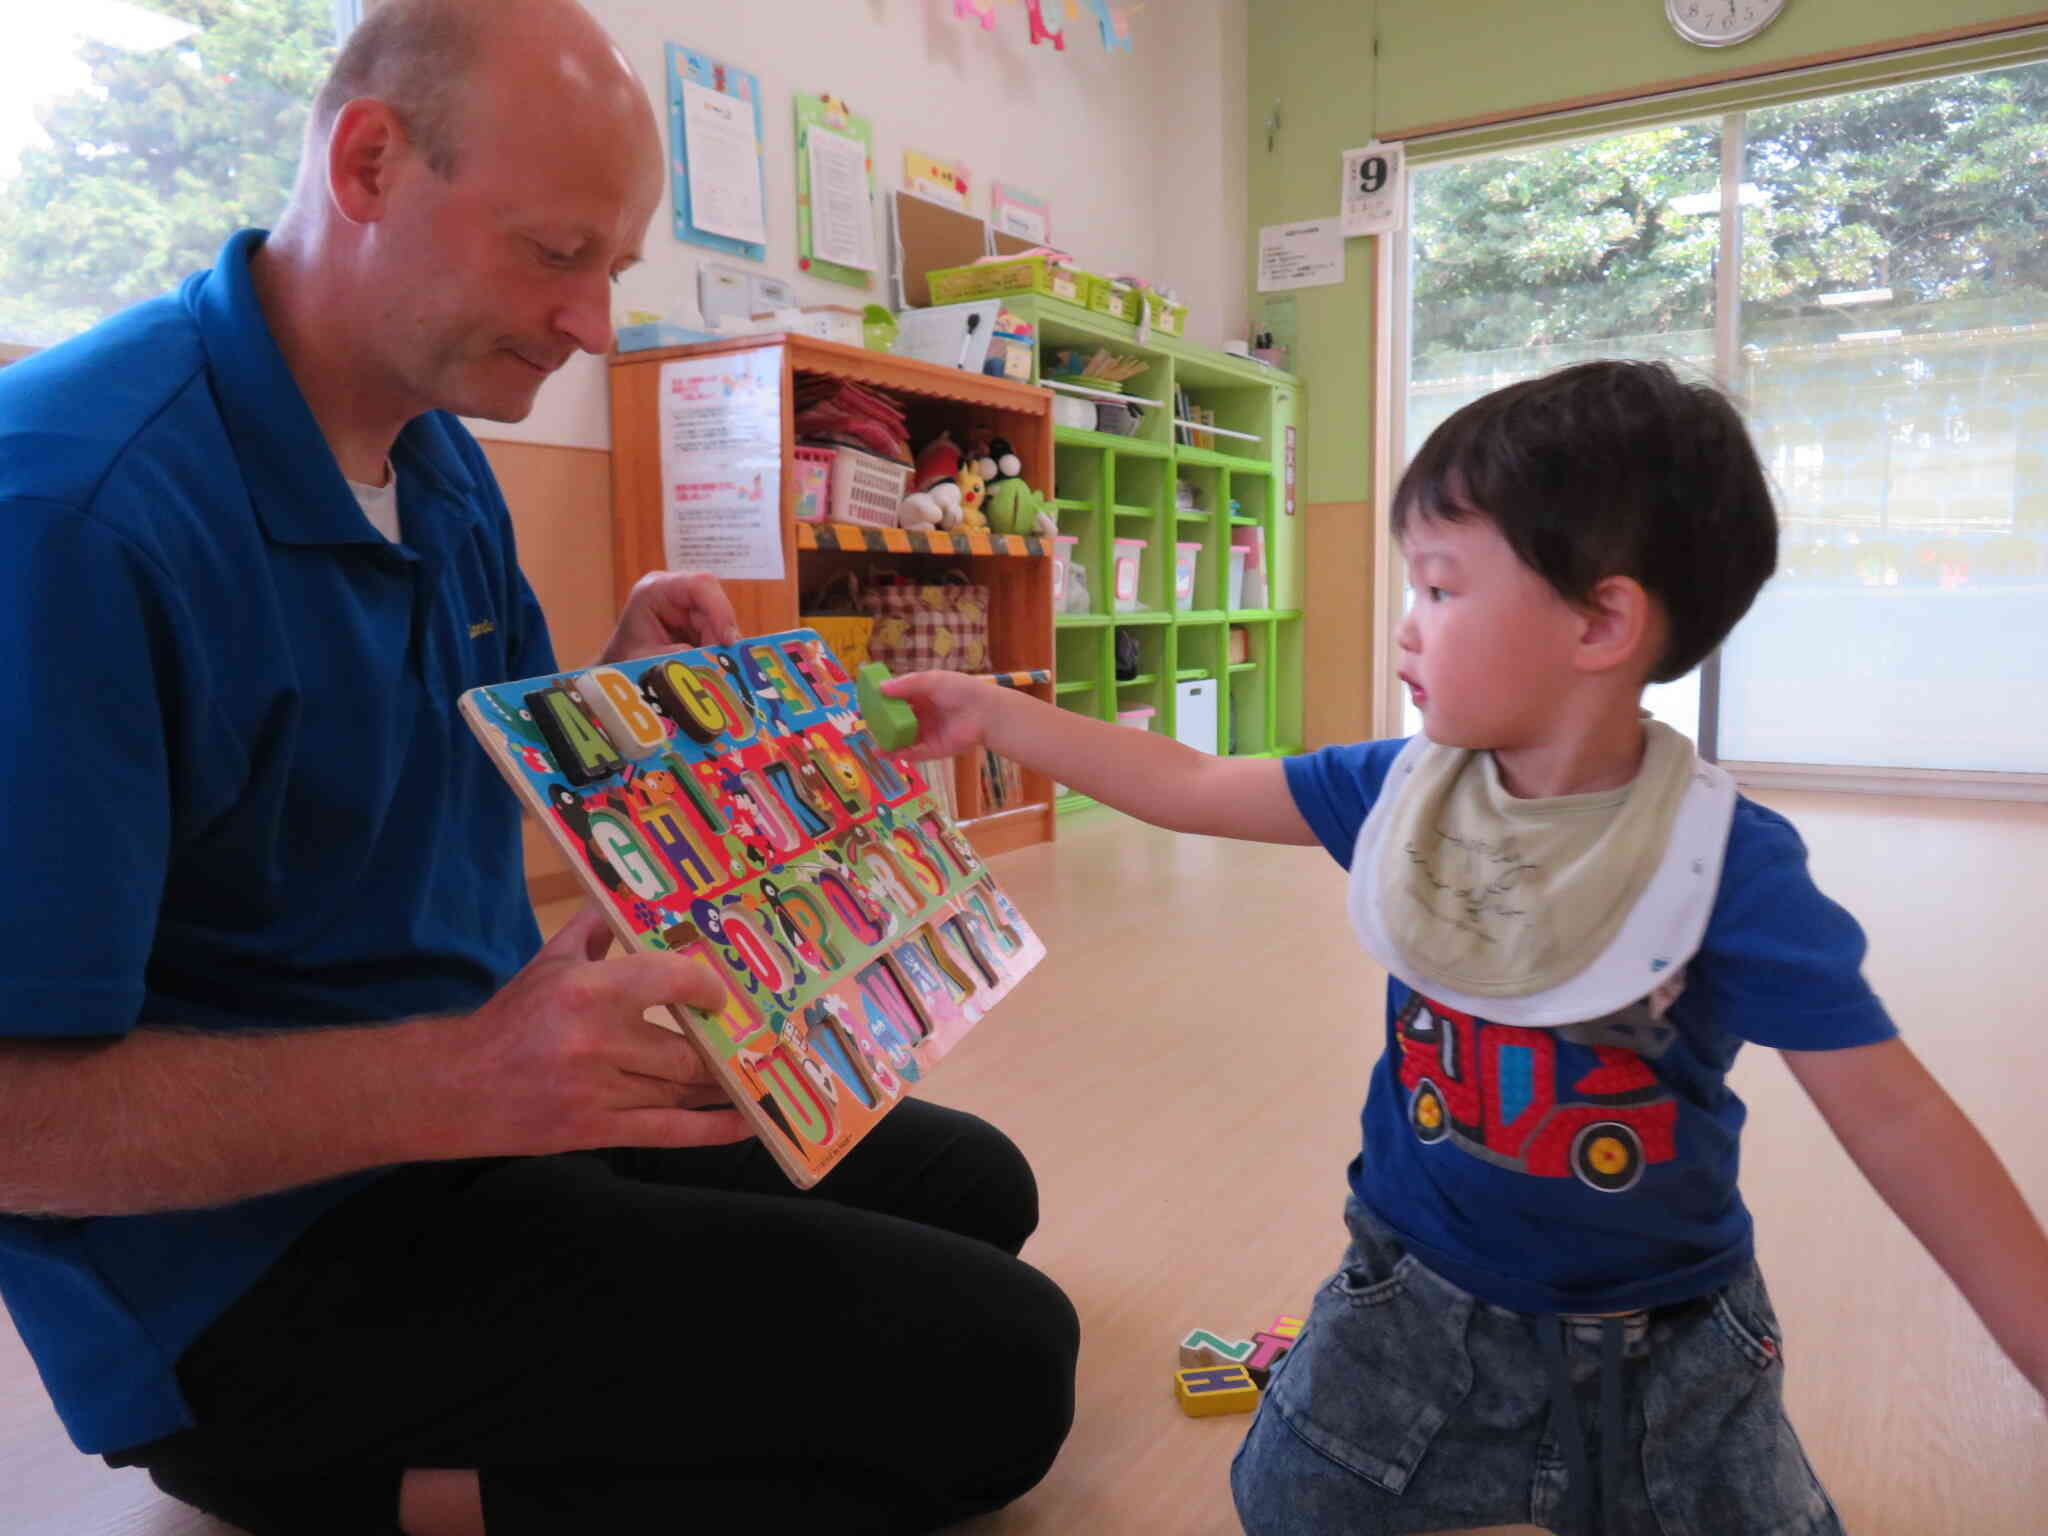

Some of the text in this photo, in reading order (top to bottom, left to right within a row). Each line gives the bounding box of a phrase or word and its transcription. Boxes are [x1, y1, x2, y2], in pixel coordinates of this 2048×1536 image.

[1359, 156, 1388, 193] 9
[544, 689, 622, 772] A
[594, 669, 666, 747] B
[664, 660, 728, 730] C
[589, 812, 672, 900] G
[641, 806, 721, 893] H
[721, 908, 789, 993] O
[777, 886, 844, 970] P
[756, 1043, 839, 1146] U
